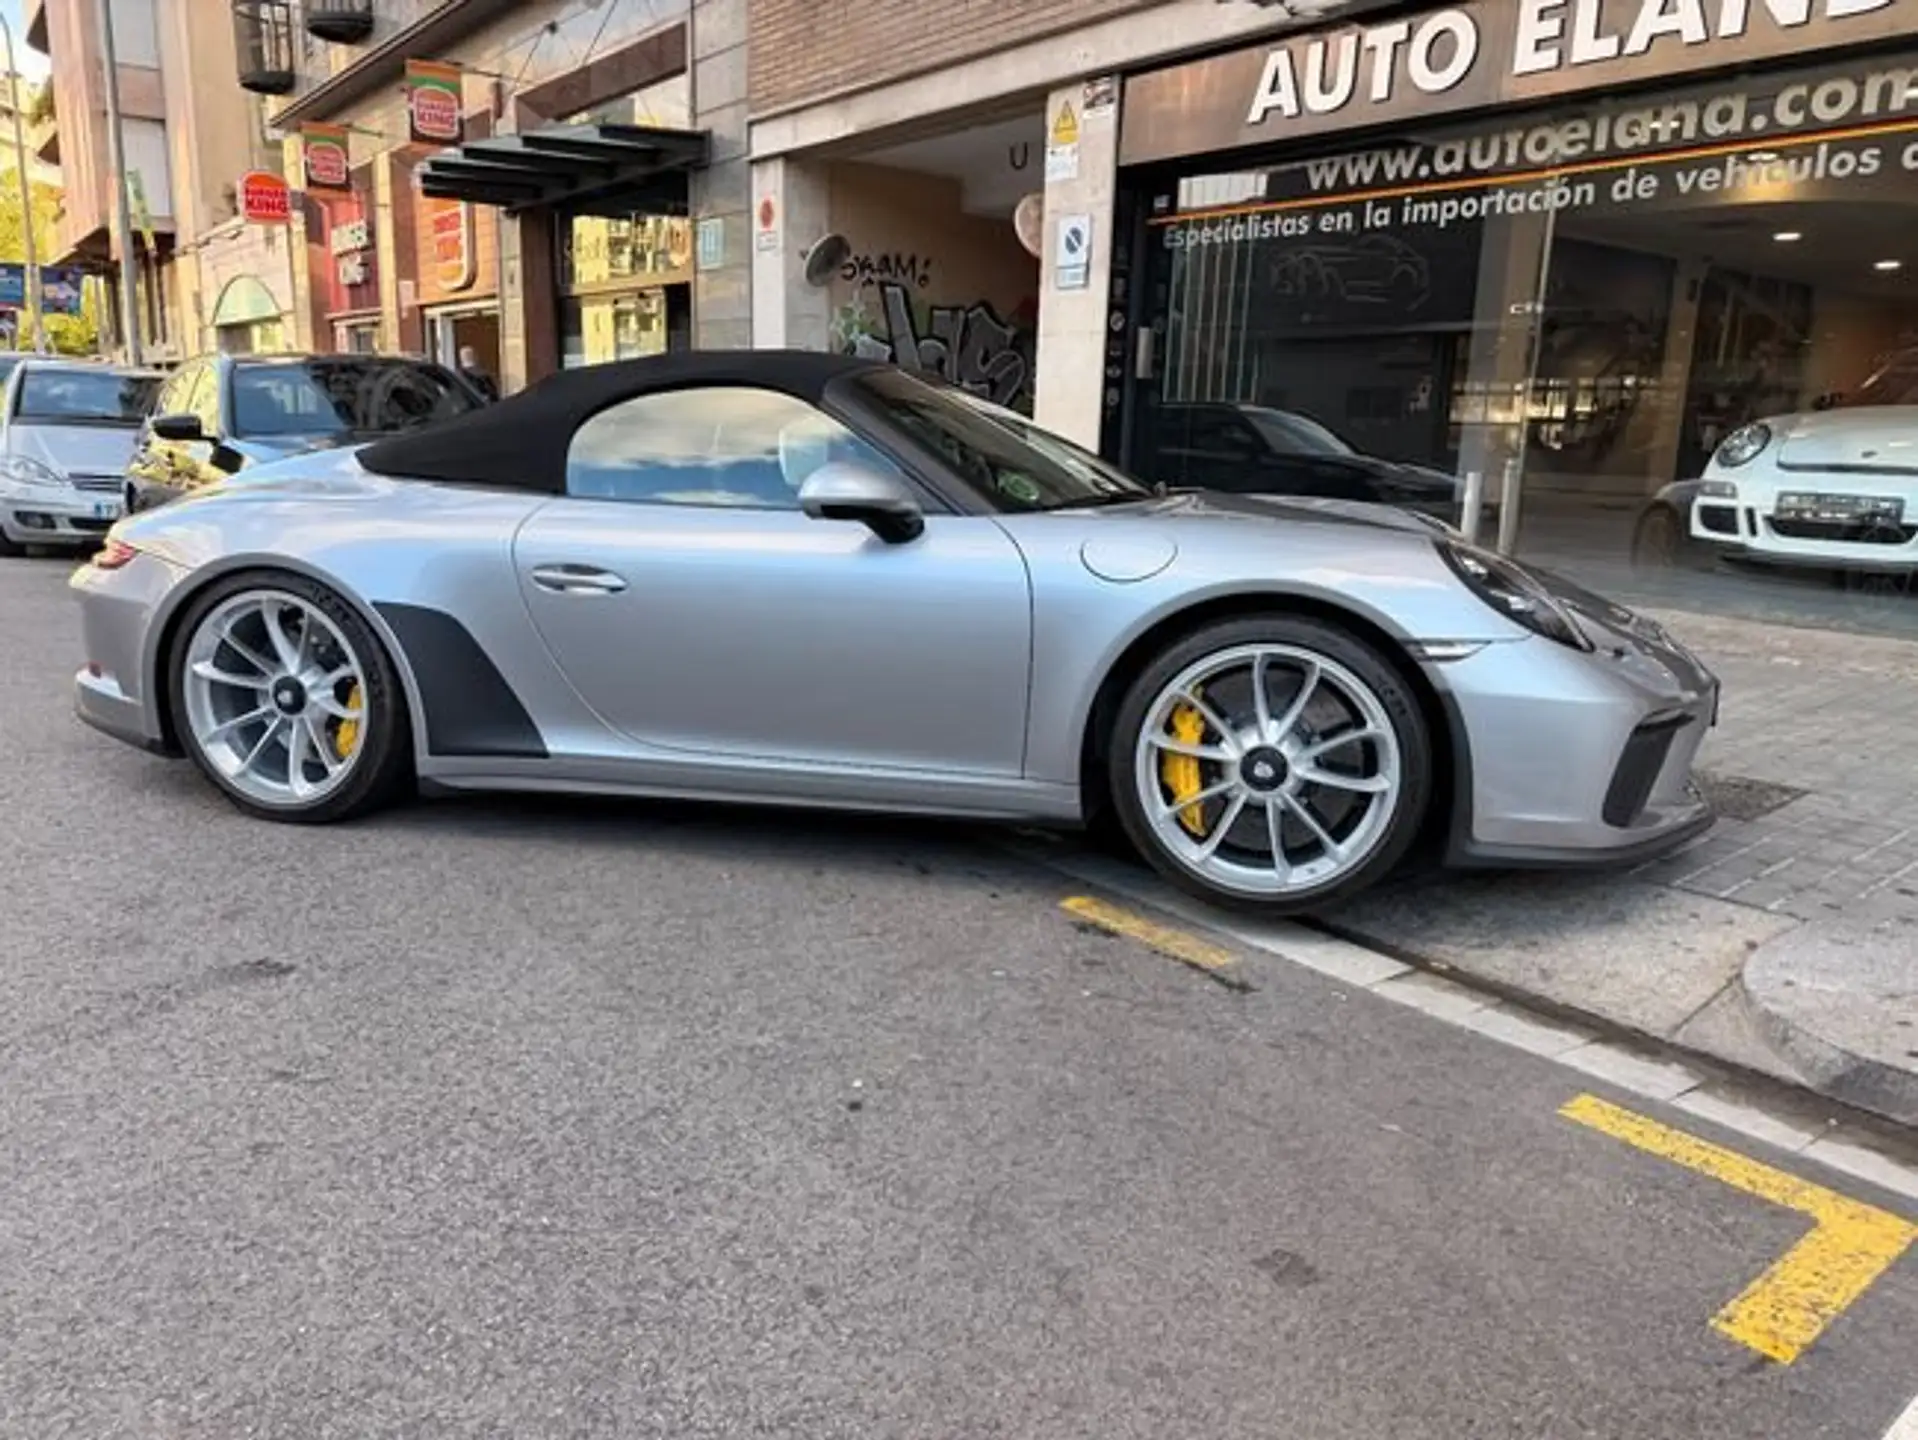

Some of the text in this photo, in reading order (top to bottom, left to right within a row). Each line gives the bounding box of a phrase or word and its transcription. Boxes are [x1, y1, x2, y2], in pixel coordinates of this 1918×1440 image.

[1247, 0, 1893, 124] AUTO ELA
[1306, 67, 1918, 190] www.autoelana.com
[1163, 214, 1310, 253] Especialistas
[1318, 210, 1353, 233] en
[1363, 200, 1392, 228] la
[1402, 176, 1595, 228] importación
[1611, 168, 1659, 201] de
